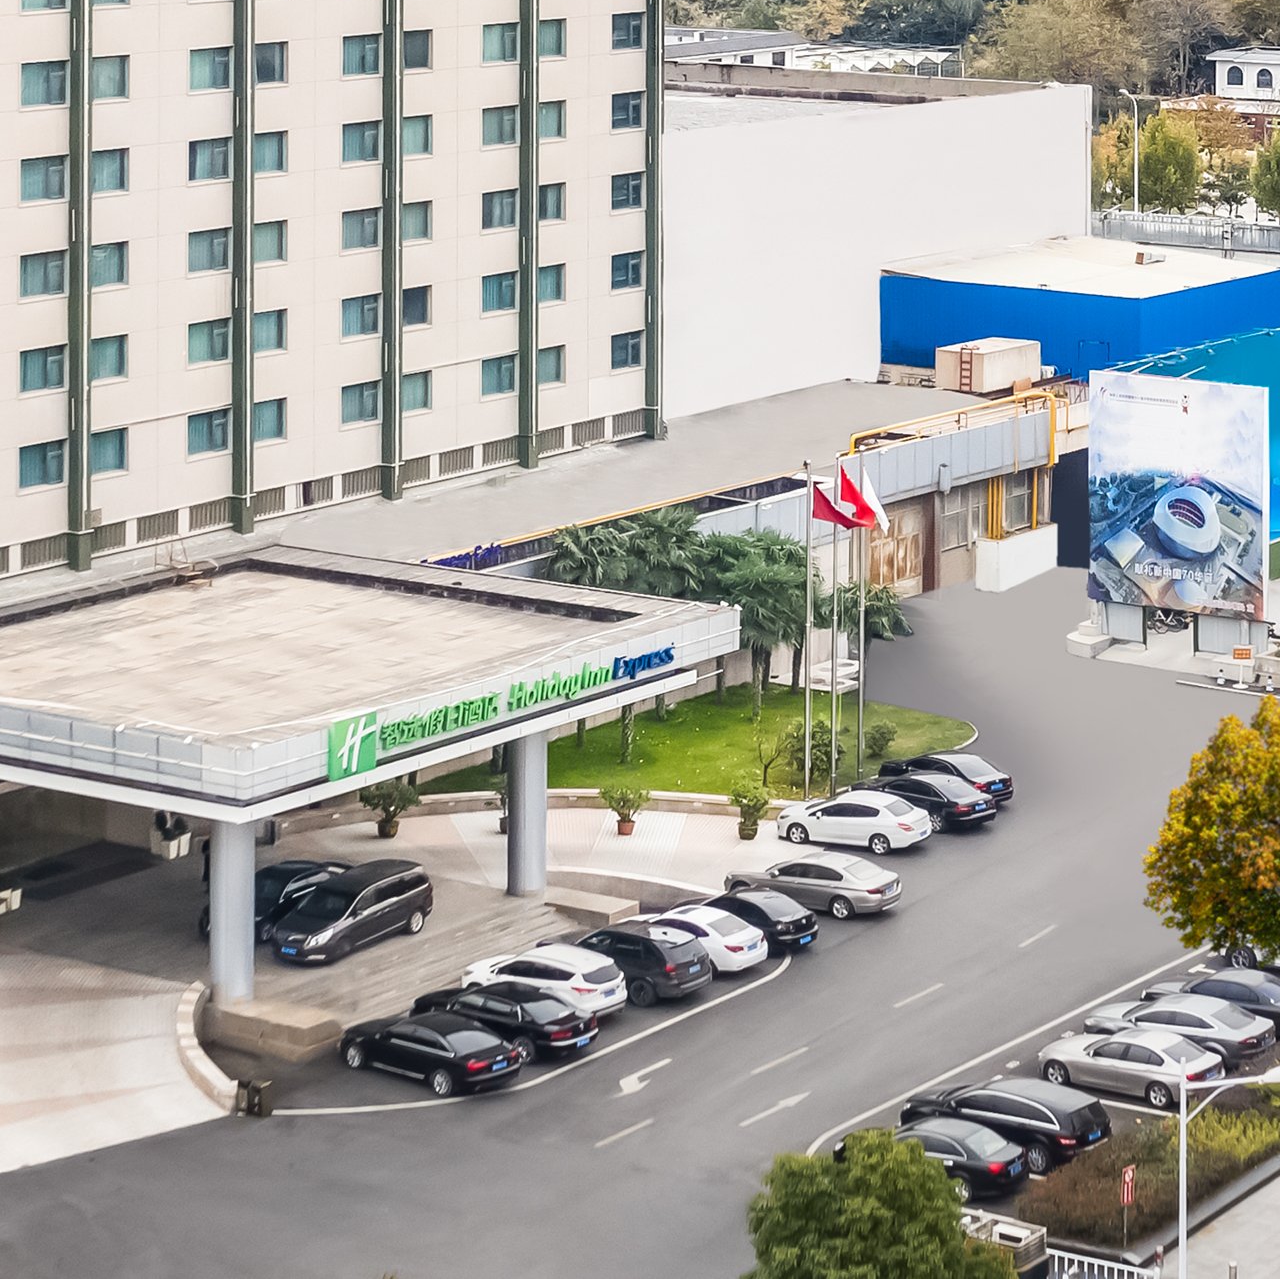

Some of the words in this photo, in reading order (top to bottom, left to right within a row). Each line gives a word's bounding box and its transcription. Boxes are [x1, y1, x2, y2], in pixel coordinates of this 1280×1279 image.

[507, 671, 582, 712] Holiday
[581, 661, 612, 689] Inn
[612, 646, 675, 680] Express
